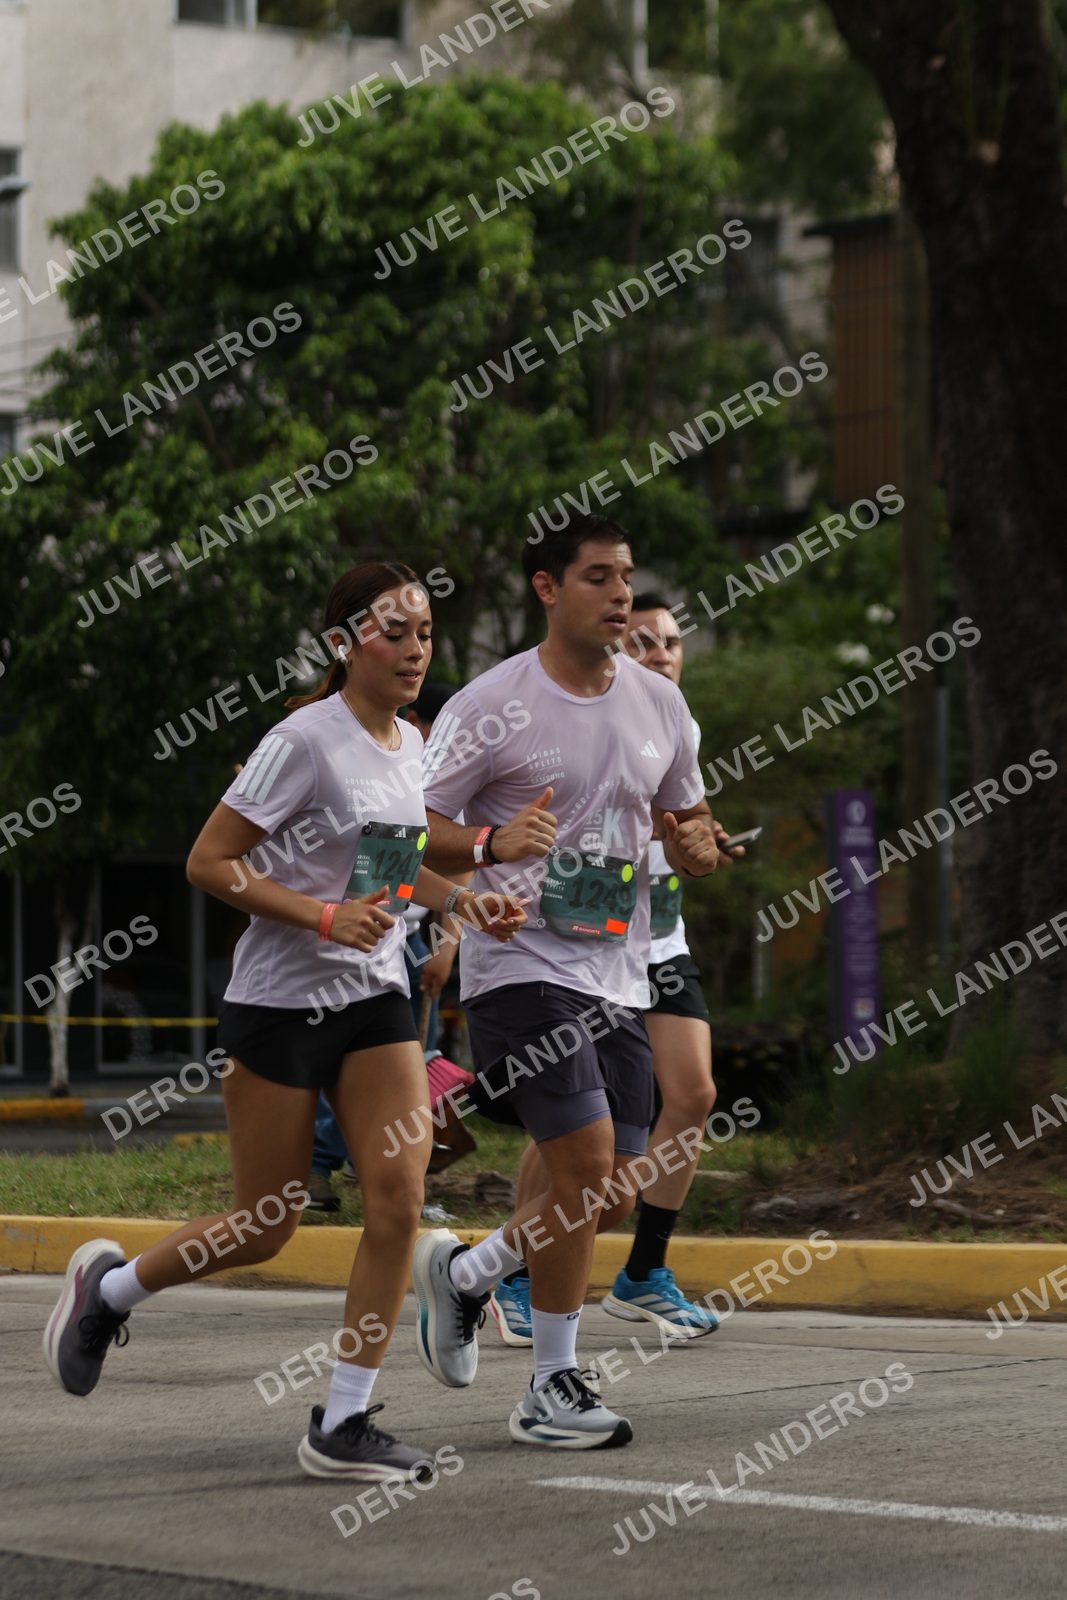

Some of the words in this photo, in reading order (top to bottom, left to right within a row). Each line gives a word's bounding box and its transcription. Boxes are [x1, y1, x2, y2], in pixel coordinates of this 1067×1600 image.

[526, 747, 561, 761] ADIDAS
[528, 757, 562, 770] SPLITS
[604, 807, 625, 848] K
